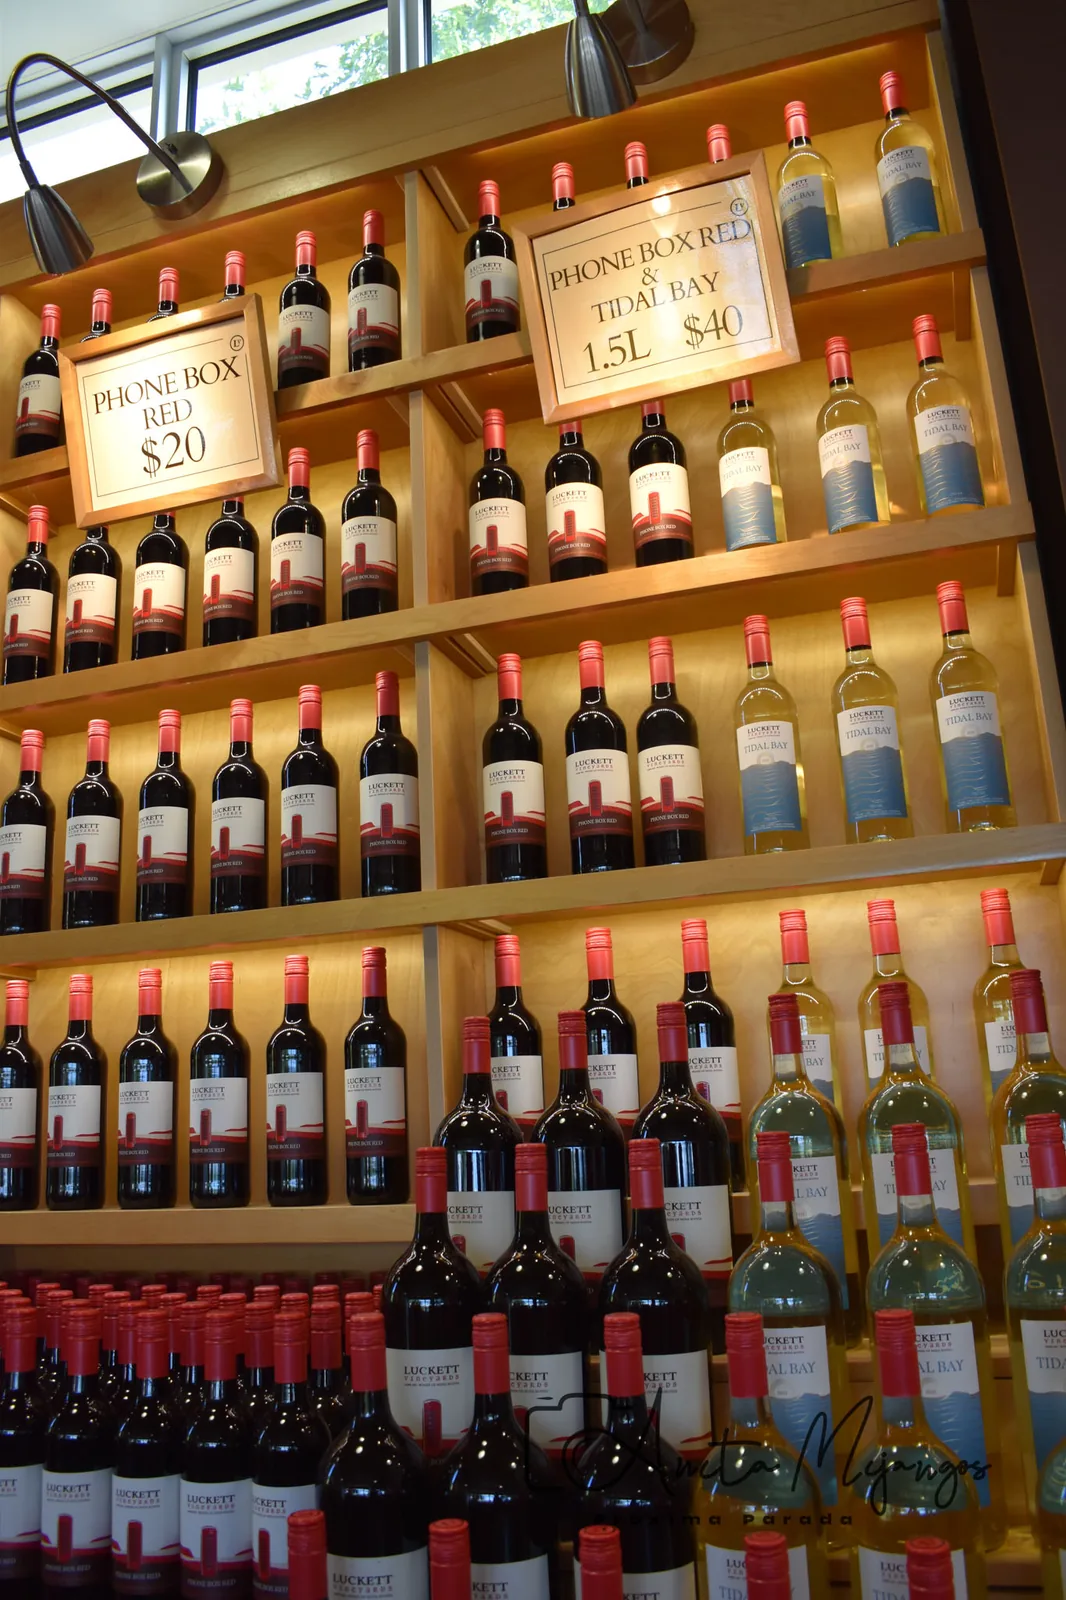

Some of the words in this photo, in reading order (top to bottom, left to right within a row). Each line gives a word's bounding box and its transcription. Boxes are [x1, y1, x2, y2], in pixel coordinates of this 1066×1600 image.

[550, 248, 634, 291] PHONE
[639, 231, 696, 263] BOX
[700, 219, 751, 248] RED
[642, 268, 659, 285] &
[351, 290, 378, 299] UCKETT
[591, 287, 666, 323] TIDAL
[671, 271, 720, 301] BAY
[584, 328, 651, 373] 1.5L
[684, 305, 743, 350] $40
[93, 372, 179, 414] PHONE
[184, 356, 241, 389] BOX
[142, 398, 192, 430] RED
[924, 424, 950, 437] TIDAL
[952, 423, 967, 433] BAY
[141, 426, 205, 478] $20
[822, 446, 842, 461] TIDAL
[844, 442, 861, 453] BAY
[949, 696, 984, 706] LUCKETT
[850, 710, 883, 719] LUCKETT
[945, 714, 974, 726] TIDAL
[976, 712, 993, 721] BAY
[747, 725, 780, 734] LUCKETT
[845, 728, 873, 739] TIDAL
[875, 727, 892, 735] BAY
[744, 743, 769, 755] TIDAL
[771, 741, 787, 749] BAY
[575, 758, 613, 768] LUCKETT
[646, 754, 684, 764] LUCKETT
[489, 769, 525, 779] LUCKETT
[368, 782, 404, 790] LUCKETT
[284, 793, 315, 803] LUCKETT
[213, 806, 242, 815] LUCKETT
[139, 815, 164, 823] UCKETT
[68, 823, 99, 832] LUCKETT
[0, 832, 22, 840] CKETT
[996, 1045, 1016, 1054] TIDA
[689, 1057, 722, 1065] UCKETT
[806, 1058, 823, 1066] BAY
[588, 1064, 616, 1072] CKETT
[347, 1076, 381, 1084] LUCKETT
[192, 1086, 225, 1094] LUCKETT
[268, 1081, 299, 1090] LUCKETT
[120, 1090, 149, 1098] LUCKETT
[793, 1165, 817, 1173] KETT
[934, 1181, 946, 1191] AY
[806, 1187, 828, 1197] BAY
[448, 1206, 482, 1214] CKETT
[549, 1206, 591, 1214] UCKETT
[665, 1202, 701, 1210] CKETT
[763, 1336, 804, 1344] UCKETT
[916, 1333, 951, 1342] CKETT
[938, 1360, 963, 1372] BAY
[1036, 1357, 1066, 1369] TIDA
[404, 1365, 459, 1375] LUCKETT
[790, 1361, 816, 1376] BAY
[510, 1372, 548, 1381] CKETT
[644, 1372, 677, 1381] KETT
[46, 1484, 90, 1492] LUCKETT
[116, 1490, 160, 1499] LUCKETT
[188, 1495, 234, 1504] LUCKETT
[253, 1500, 286, 1511] UCKETT
[333, 1574, 392, 1585] LUCKETT
[473, 1582, 508, 1592] KETT
